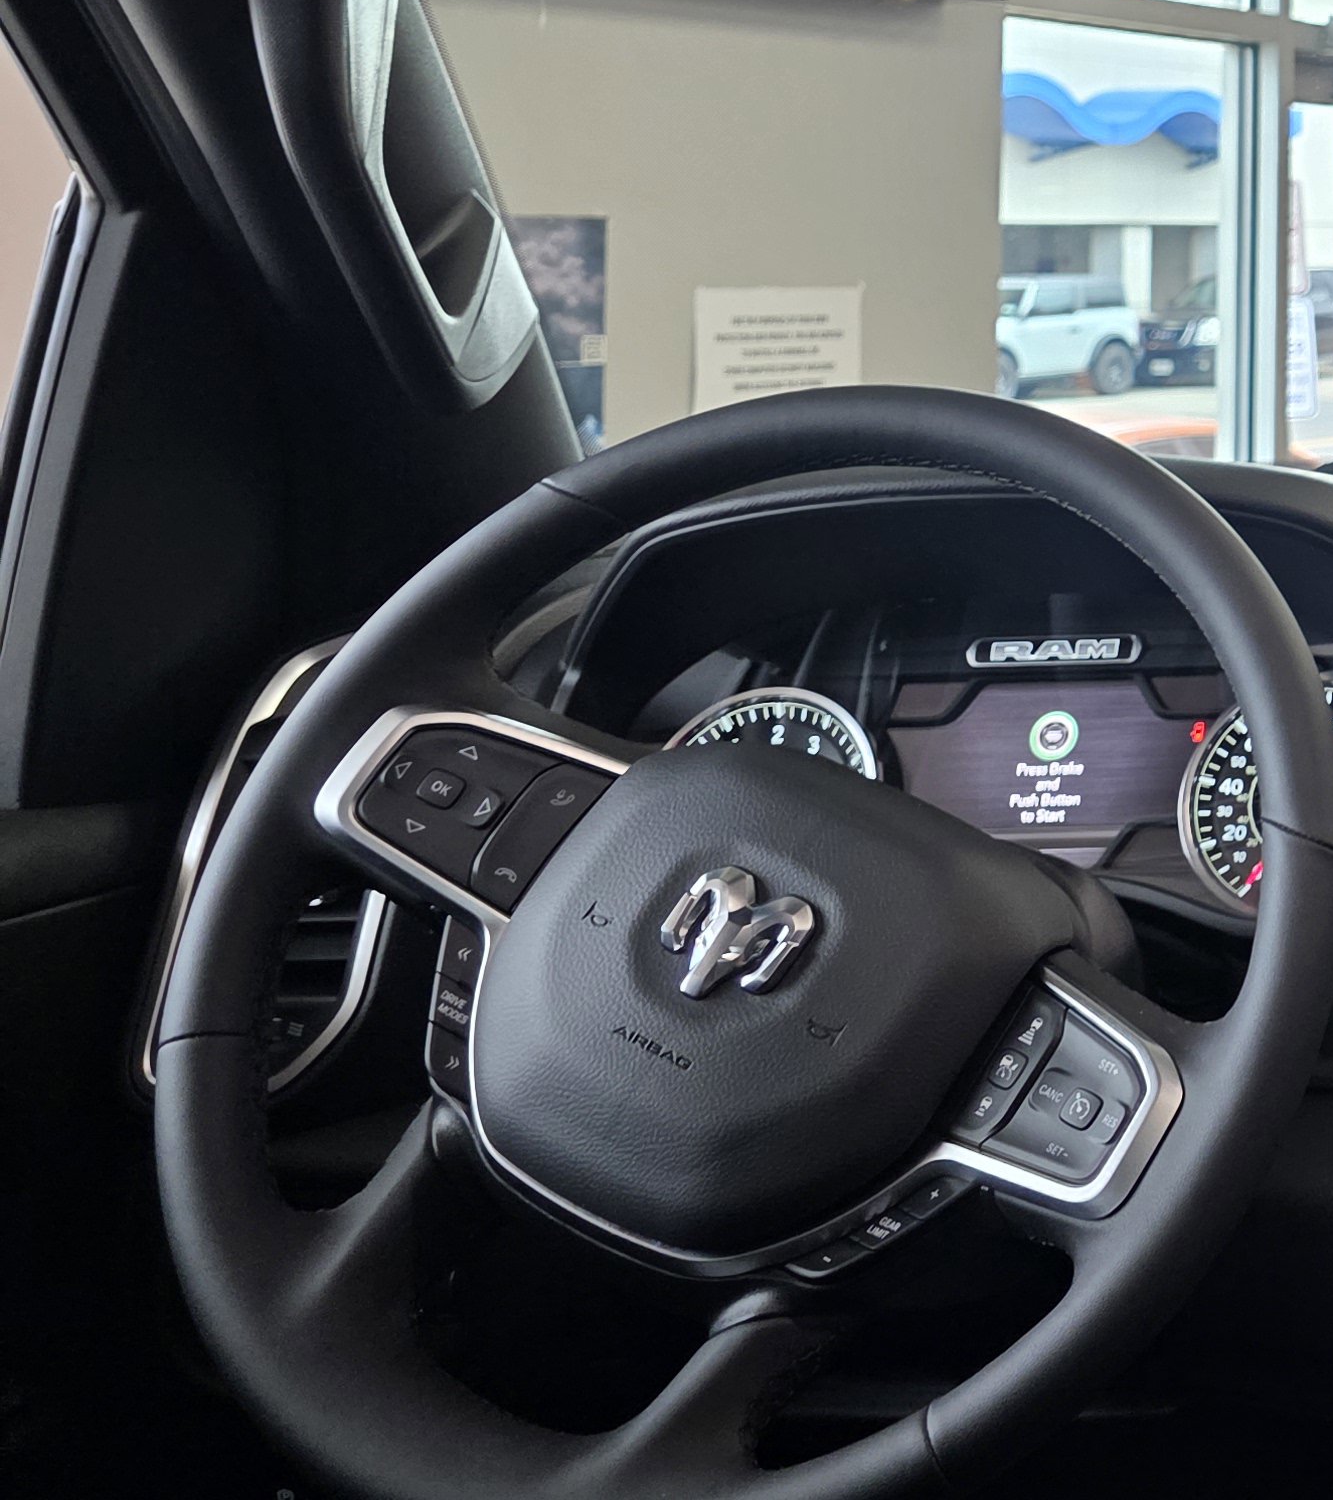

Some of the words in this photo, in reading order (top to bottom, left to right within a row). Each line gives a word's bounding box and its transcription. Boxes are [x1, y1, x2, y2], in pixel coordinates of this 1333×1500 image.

[990, 638, 1121, 662] RAM
[770, 724, 785, 746] 2
[808, 735, 821, 756] 3
[1016, 762, 1048, 776] Press
[1049, 761, 1085, 776] Brake
[430, 779, 453, 798] OK
[1035, 776, 1061, 792] and
[1218, 777, 1245, 796] 40
[1009, 792, 1040, 808] Push
[1040, 792, 1082, 808] Button
[1020, 810, 1035, 824] to
[1036, 808, 1066, 824] Start
[1216, 805, 1234, 818] 30
[1221, 824, 1248, 842] 20
[1232, 850, 1248, 864] 10
[440, 989, 468, 1010] DRIVE
[437, 1004, 469, 1025] MODES
[612, 1025, 694, 1072] AIRBAG
[1038, 1082, 1064, 1105] CANC
[1102, 1113, 1119, 1129] RES
[865, 1223, 890, 1241] LIMIT
[878, 1215, 902, 1233] GEAR
